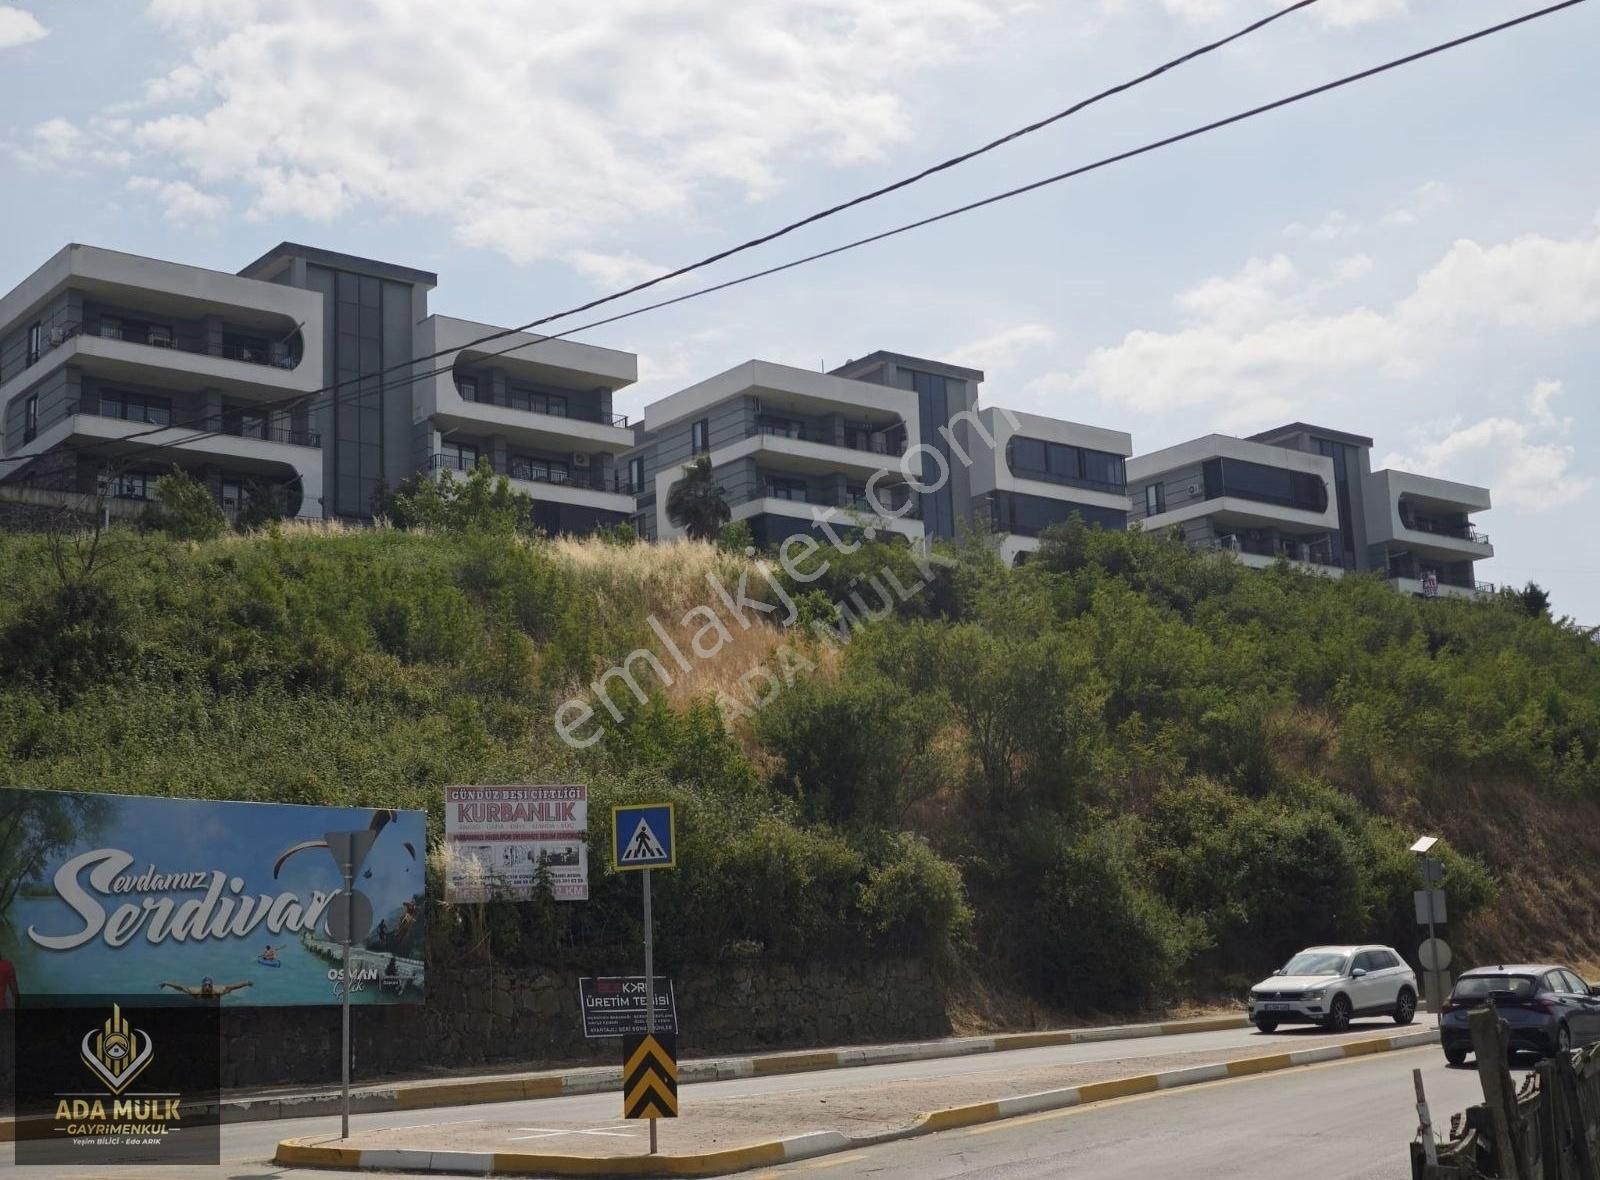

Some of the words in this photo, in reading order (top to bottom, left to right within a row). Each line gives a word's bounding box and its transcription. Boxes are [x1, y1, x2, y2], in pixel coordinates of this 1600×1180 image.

[451, 788, 499, 800] GÜNDÜZ
[458, 802, 577, 822] KURBANLIK
[586, 994, 630, 1007] ÜRETİM
[632, 993, 670, 1006] TEİSİ
